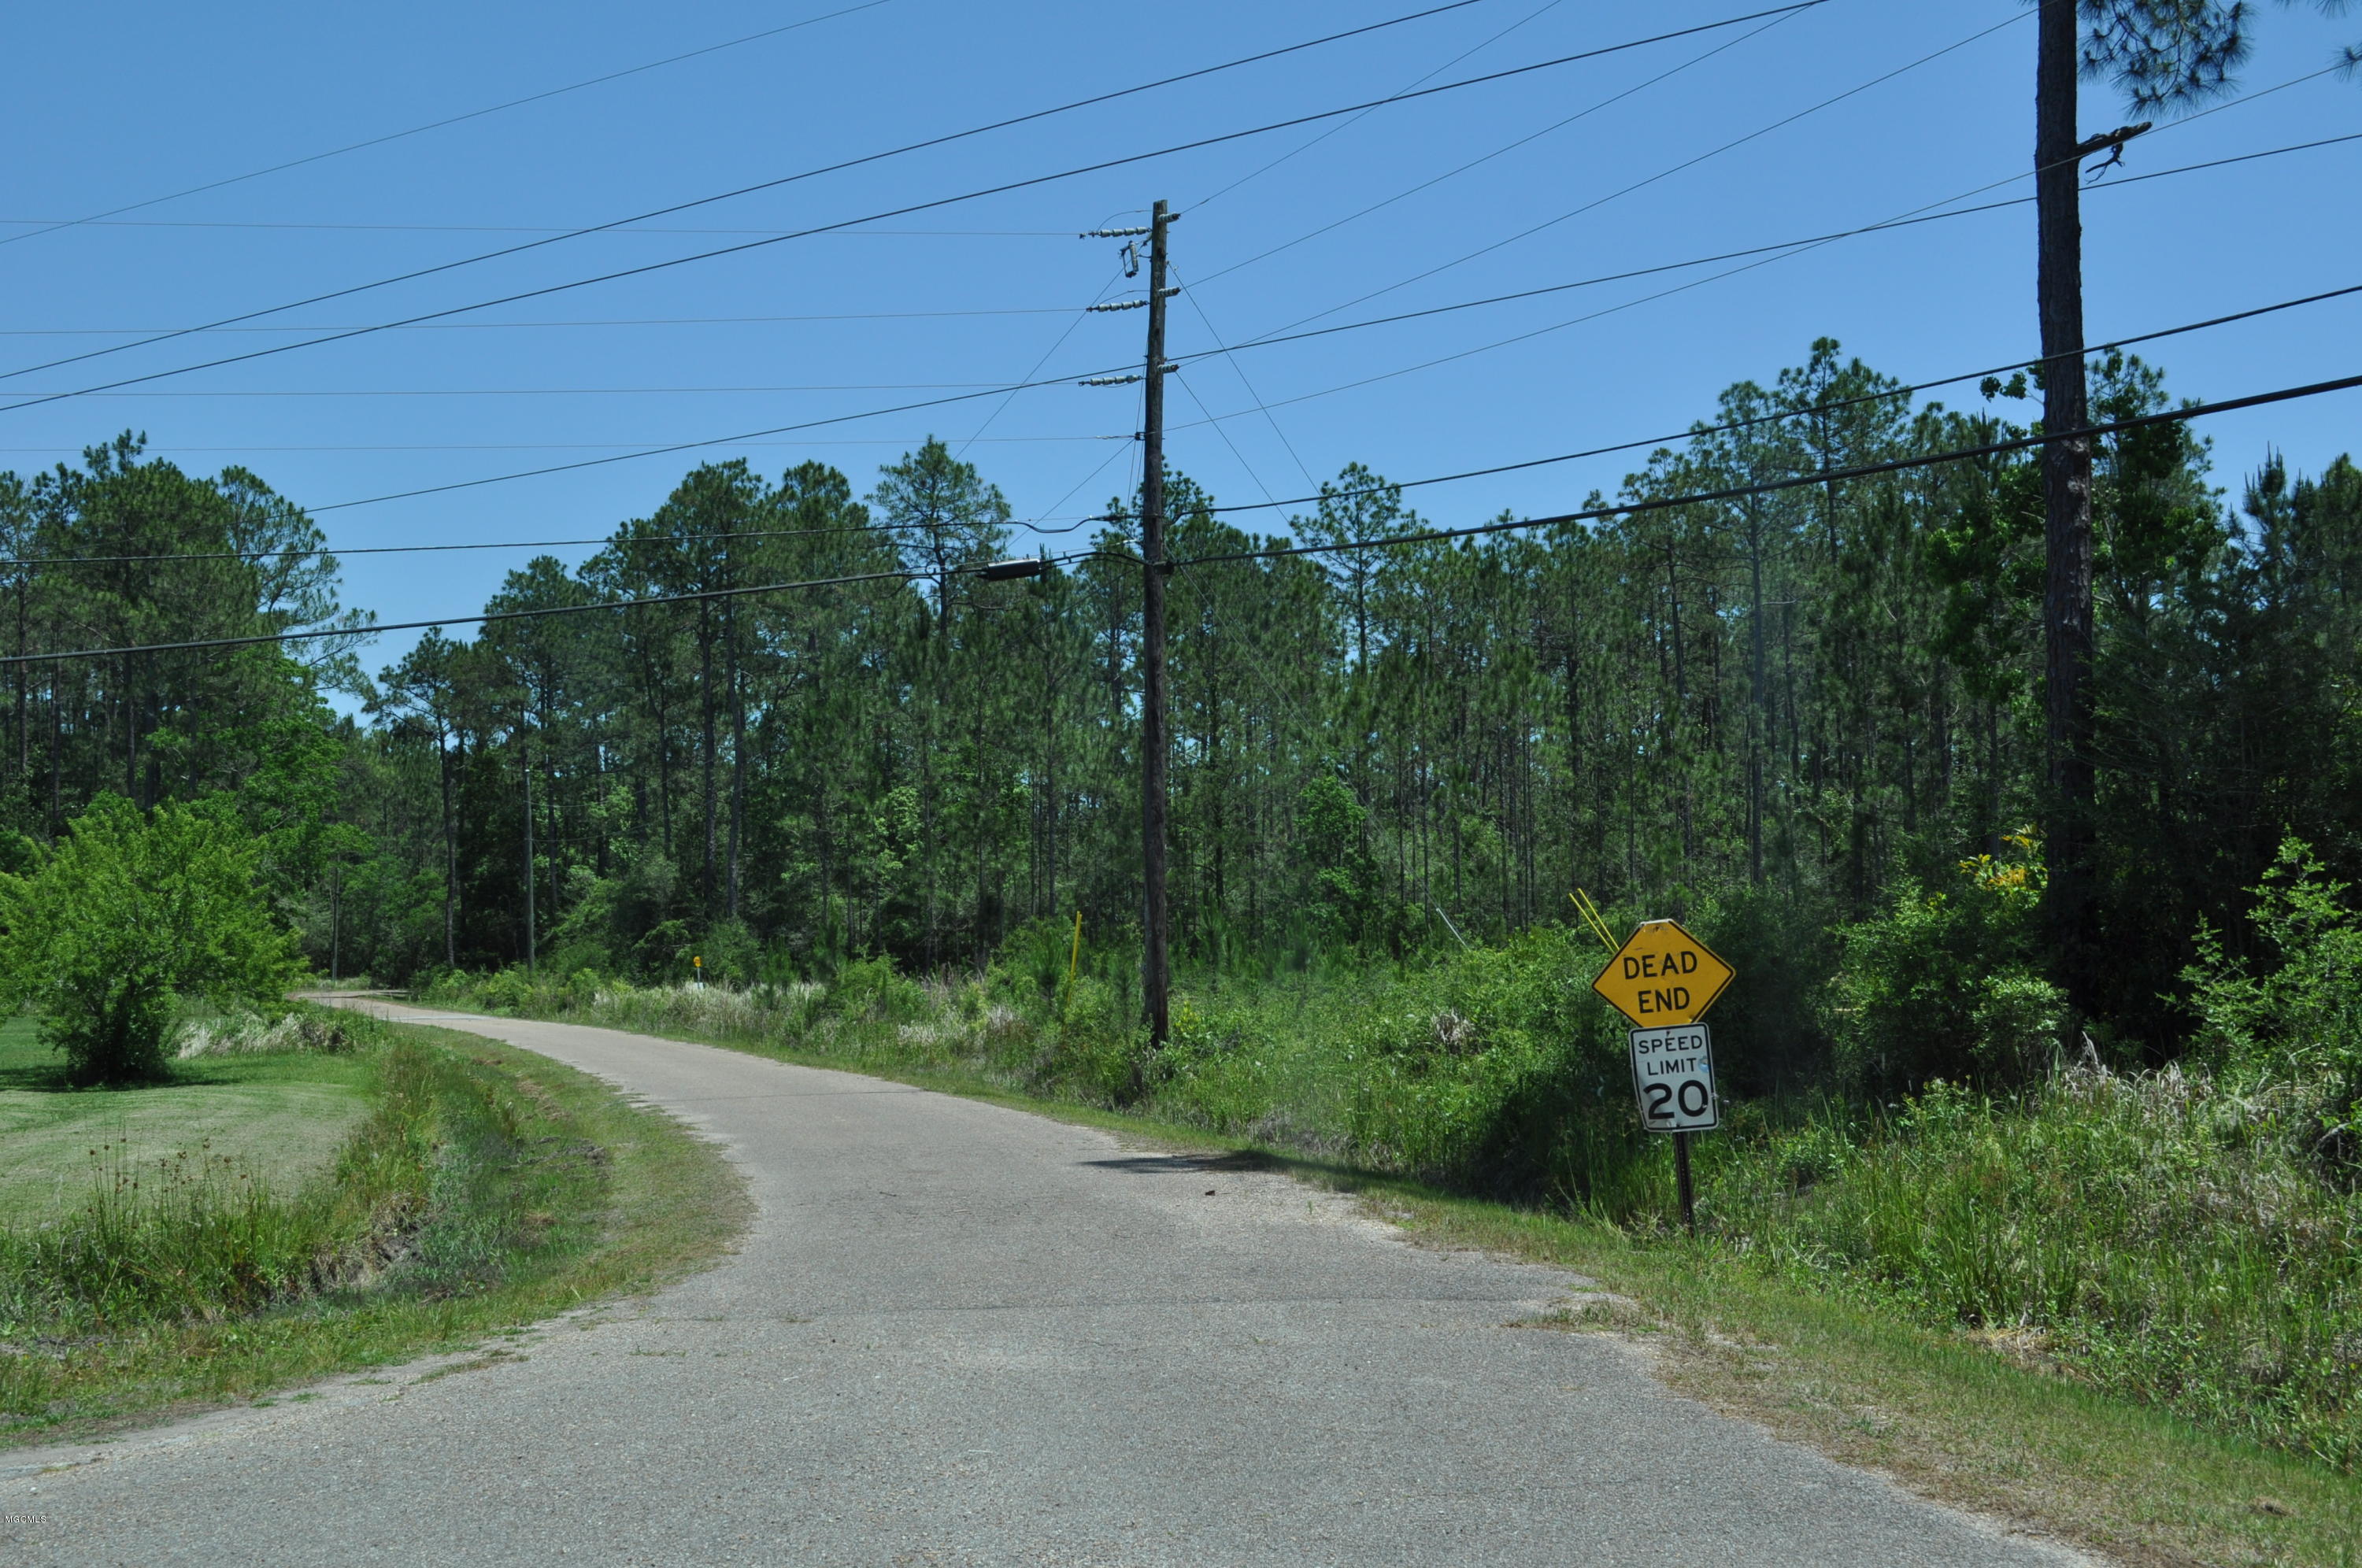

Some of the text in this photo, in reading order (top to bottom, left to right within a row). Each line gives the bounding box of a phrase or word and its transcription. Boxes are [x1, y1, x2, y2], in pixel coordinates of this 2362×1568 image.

[1623, 951, 1697, 980] DEAD
[1638, 986, 1690, 1014] END
[1638, 1035, 1703, 1054] SPEED
[1647, 1057, 1697, 1075] LIMIT
[1643, 1079, 1709, 1119] 20
